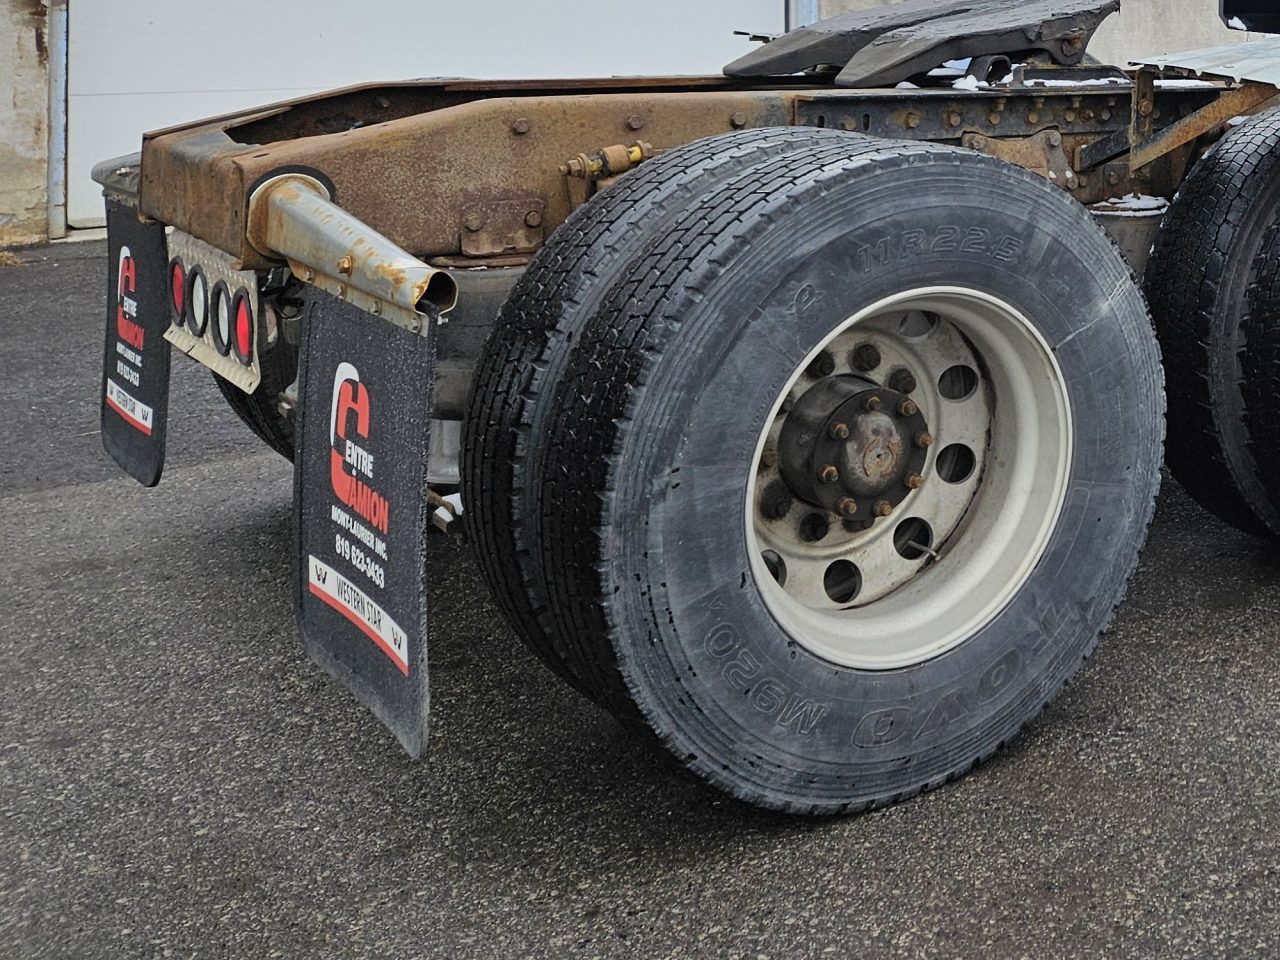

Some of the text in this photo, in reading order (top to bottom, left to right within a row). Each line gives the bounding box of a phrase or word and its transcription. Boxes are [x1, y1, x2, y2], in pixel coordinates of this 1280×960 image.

[335, 534, 351, 561] 819
[336, 576, 382, 632] WESTERN STAR
[703, 621, 827, 737] M920
